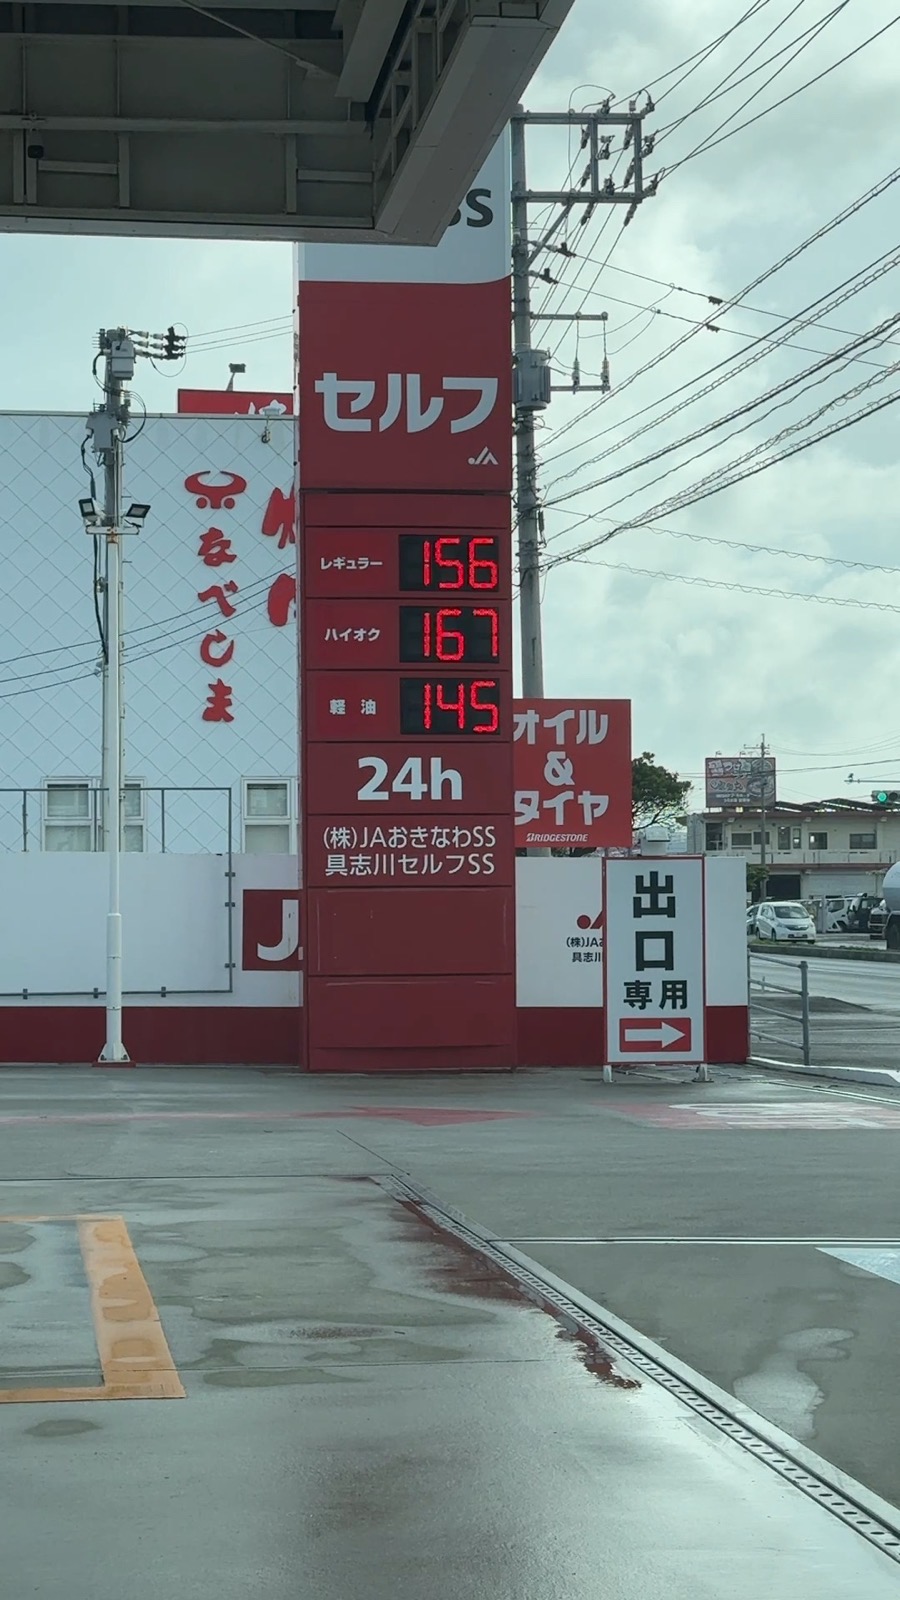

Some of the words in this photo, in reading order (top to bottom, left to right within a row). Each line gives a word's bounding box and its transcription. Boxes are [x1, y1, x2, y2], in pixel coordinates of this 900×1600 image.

[448, 188, 493, 227] S
[314, 372, 499, 434] セルフ
[320, 557, 383, 570] レギュラー
[423, 538, 498, 589] 156
[324, 628, 381, 641] ハイオク
[423, 609, 499, 661] 167
[424, 681, 499, 732] 145
[513, 709, 609, 745] オイル
[357, 756, 463, 801] 24h
[543, 751, 575, 786] &
[514, 790, 609, 826] タイヤ
[323, 826, 497, 849] (株)JAおきなわSS
[526, 832, 588, 842] BRIDGESTONE
[325, 853, 495, 876] 具志川セルフSS
[257, 899, 303, 961] J
[633, 871, 676, 971] 出口
[623, 980, 689, 1010] 専用
